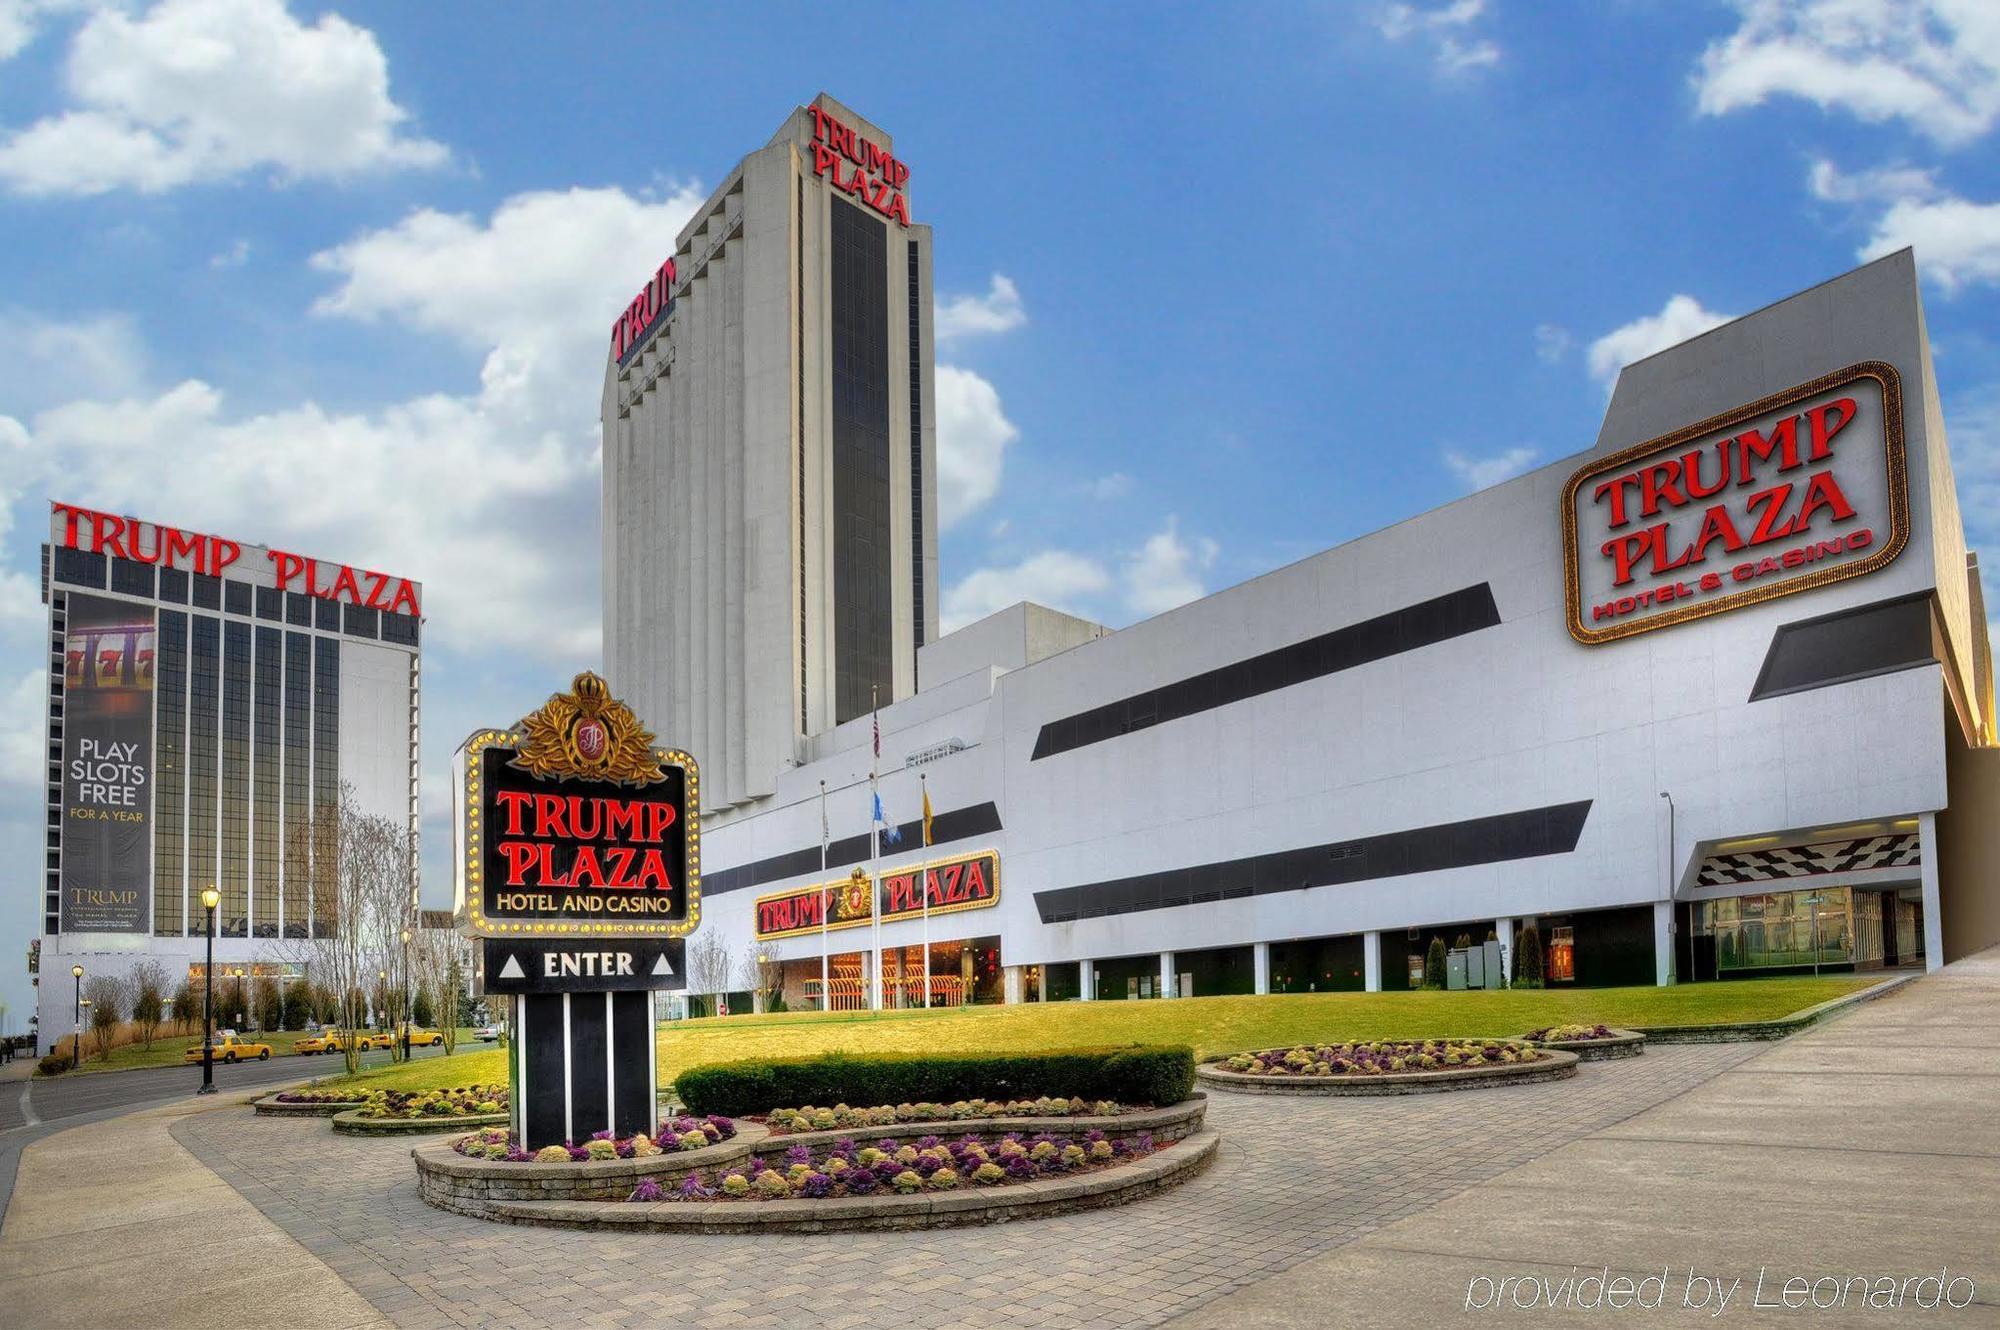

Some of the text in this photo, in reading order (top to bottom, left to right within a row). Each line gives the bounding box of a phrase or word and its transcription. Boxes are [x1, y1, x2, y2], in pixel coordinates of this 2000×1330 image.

[808, 104, 910, 190] TRUMP
[808, 139, 910, 228] PLAZA
[1594, 398, 1857, 529] TRUMP
[1601, 471, 1857, 587] PLAZA
[53, 503, 421, 617] TRUMP PLAZA
[1593, 529, 1874, 621] HOTEL & CASINO
[70, 760, 145, 785] SLOTS
[80, 738, 138, 762] PLAY
[70, 808, 144, 823] FOR A YEAR
[80, 783, 136, 806] FREE
[496, 790, 676, 842] TRUMP
[498, 842, 673, 889] PLAZA
[71, 887, 138, 906] TRUMP
[497, 894, 671, 913] HOTEL AND CASINO
[759, 861, 989, 932] TRUMP PLAZA
[543, 952, 635, 977] ENTER
